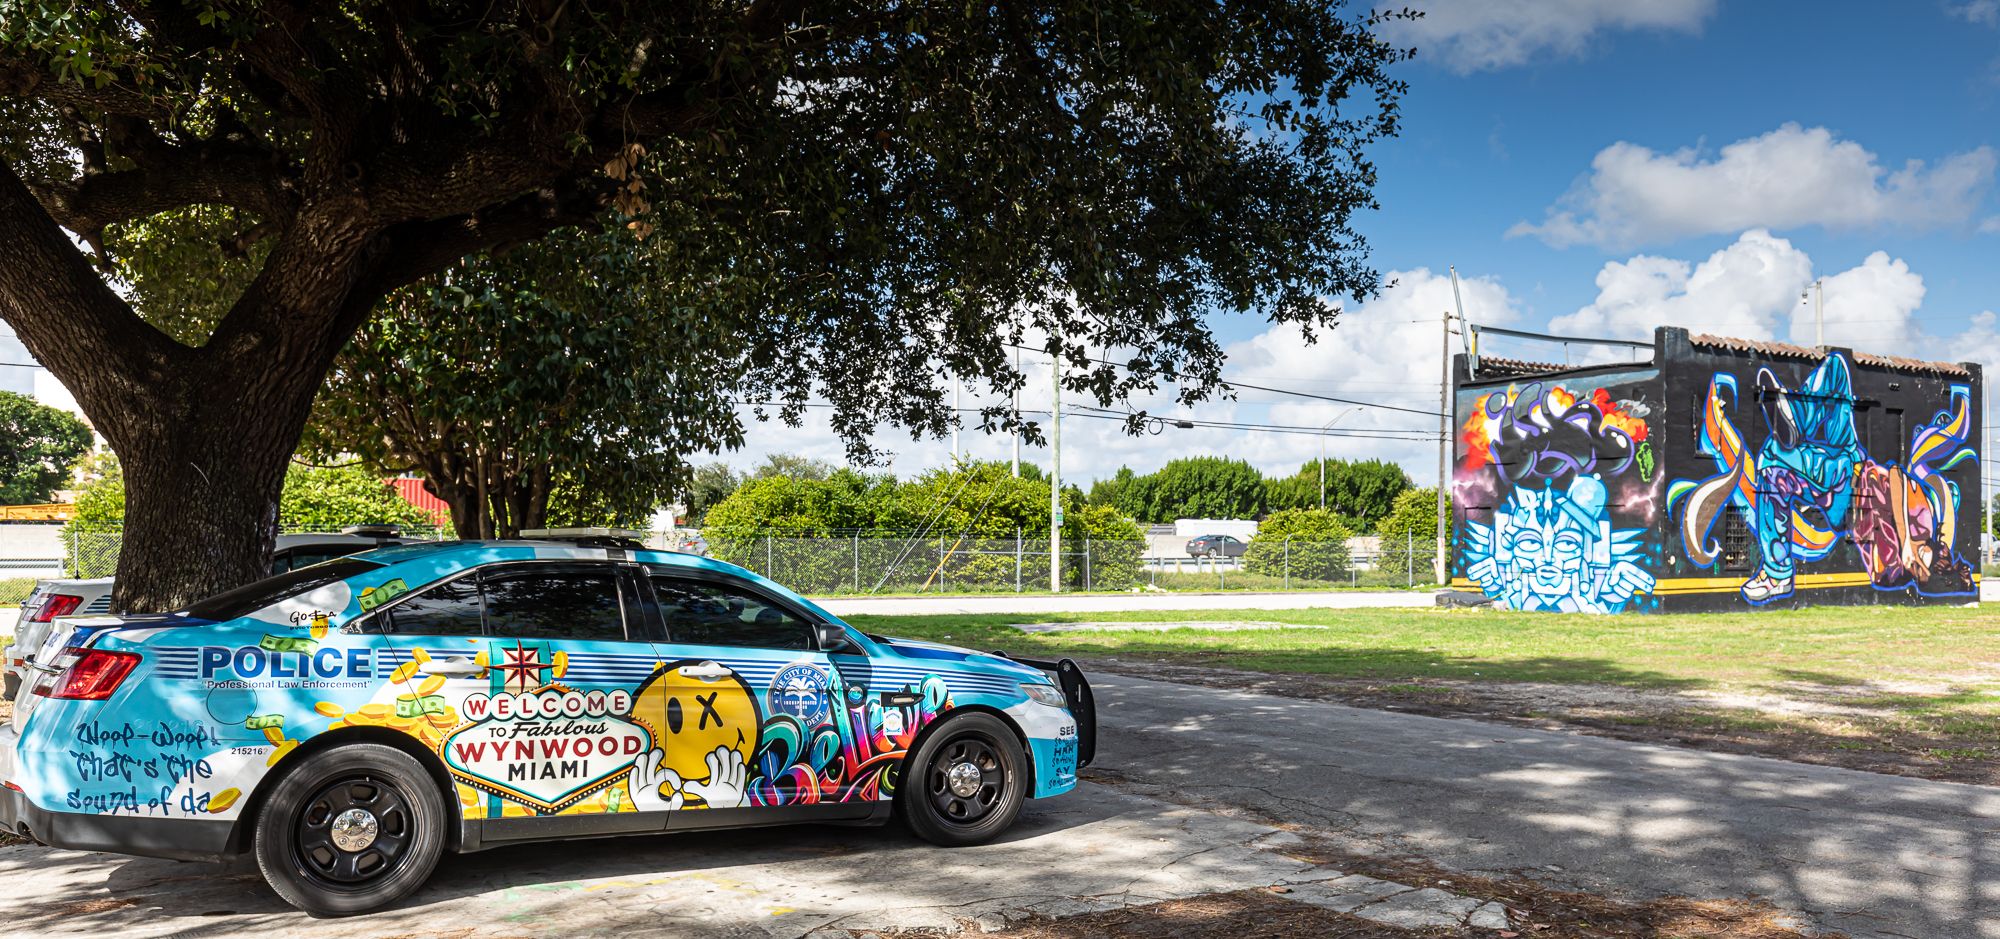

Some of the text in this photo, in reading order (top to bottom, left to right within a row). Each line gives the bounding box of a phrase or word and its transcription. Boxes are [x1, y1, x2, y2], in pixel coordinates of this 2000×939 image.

[202, 646, 372, 678] POLICE
[202, 679, 373, 689] "Professional Law Enforcement"
[774, 678, 786, 696] THE
[783, 668, 800, 680] CITY
[802, 668, 812, 676] OF
[467, 695, 626, 716] WELCOME
[806, 710, 826, 727] DEPT.
[488, 727, 507, 738] TO
[1059, 725, 1075, 736] SEE
[455, 735, 642, 764] WYNWOOD
[507, 759, 588, 782] MIAMI
[147, 785, 173, 815] of
